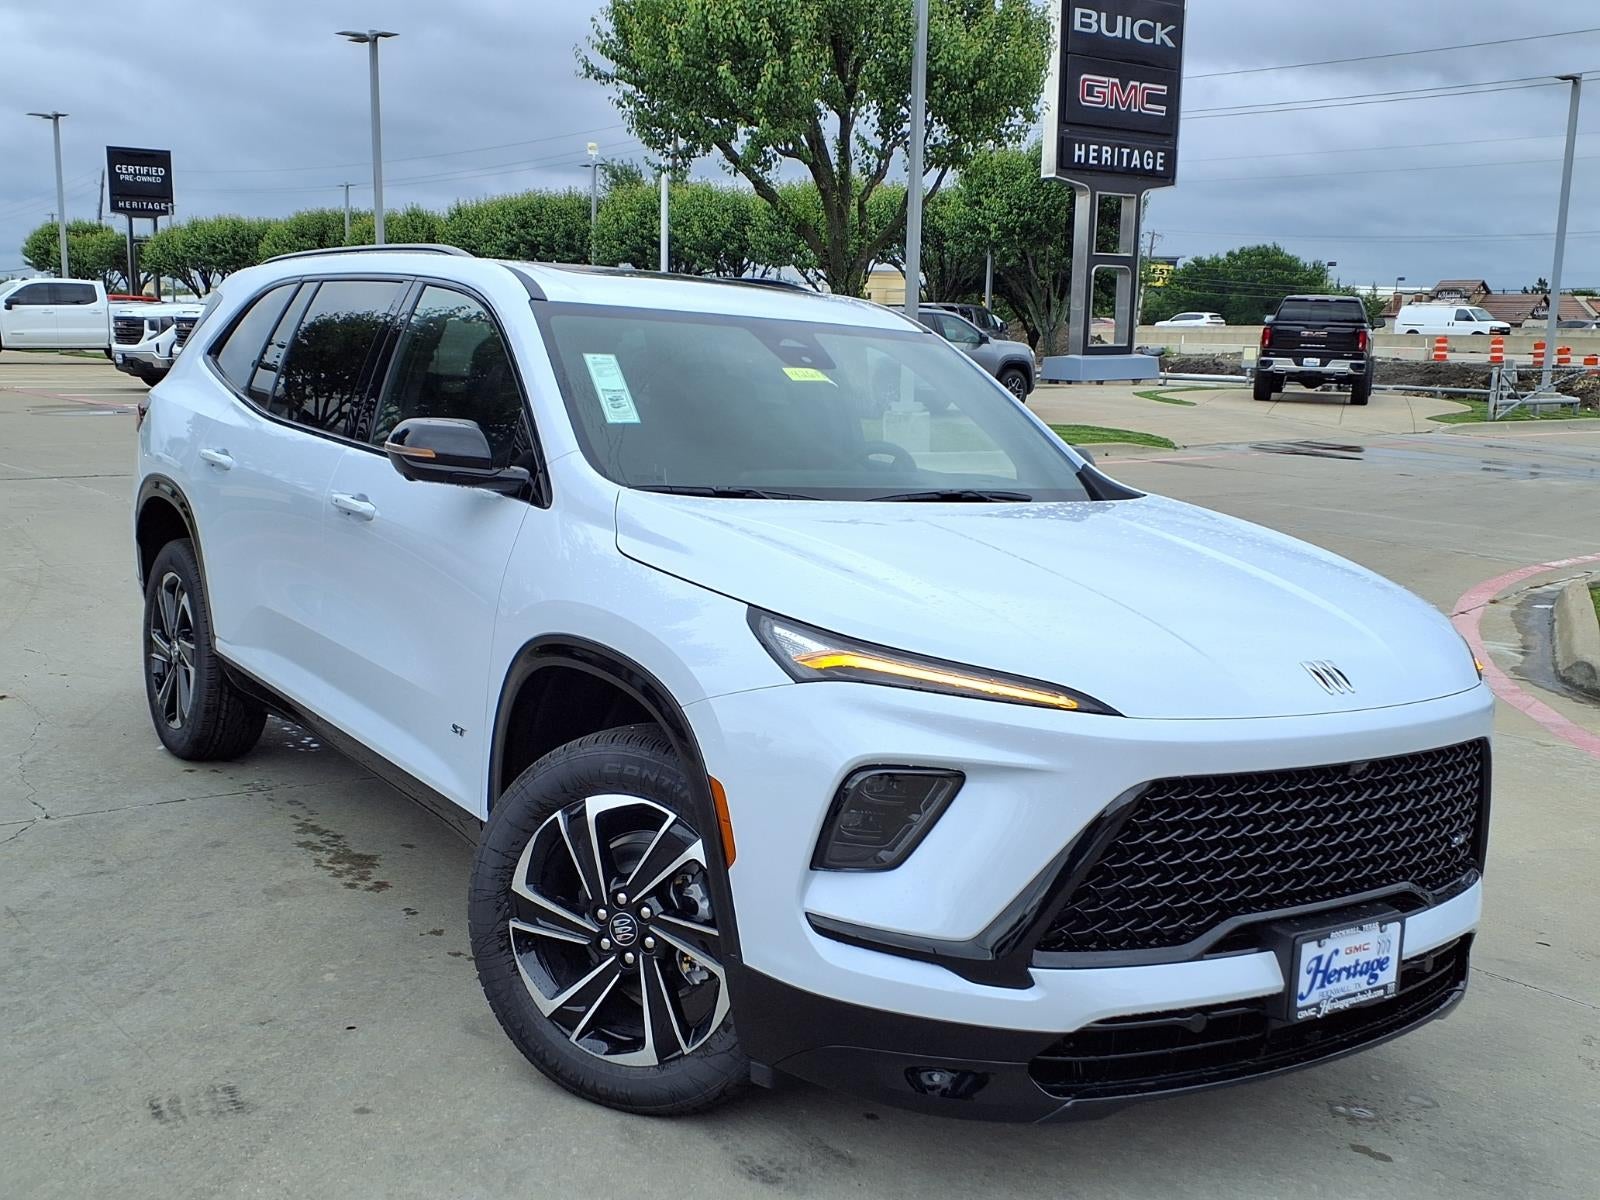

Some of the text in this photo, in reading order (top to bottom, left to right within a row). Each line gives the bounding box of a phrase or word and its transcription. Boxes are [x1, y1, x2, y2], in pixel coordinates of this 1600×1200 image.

[1074, 7, 1176, 48] BUICK
[1079, 74, 1168, 116] GMC
[1074, 143, 1165, 171] HERITAGE
[115, 164, 165, 175] CERTIFIED
[120, 174, 161, 182] PRE-OWNED
[118, 201, 166, 210] HERITAGE
[450, 723, 467, 737] ST
[1344, 942, 1371, 955] GMC
[1298, 948, 1390, 1001] Heritage
[1297, 1007, 1317, 1020] GMC
